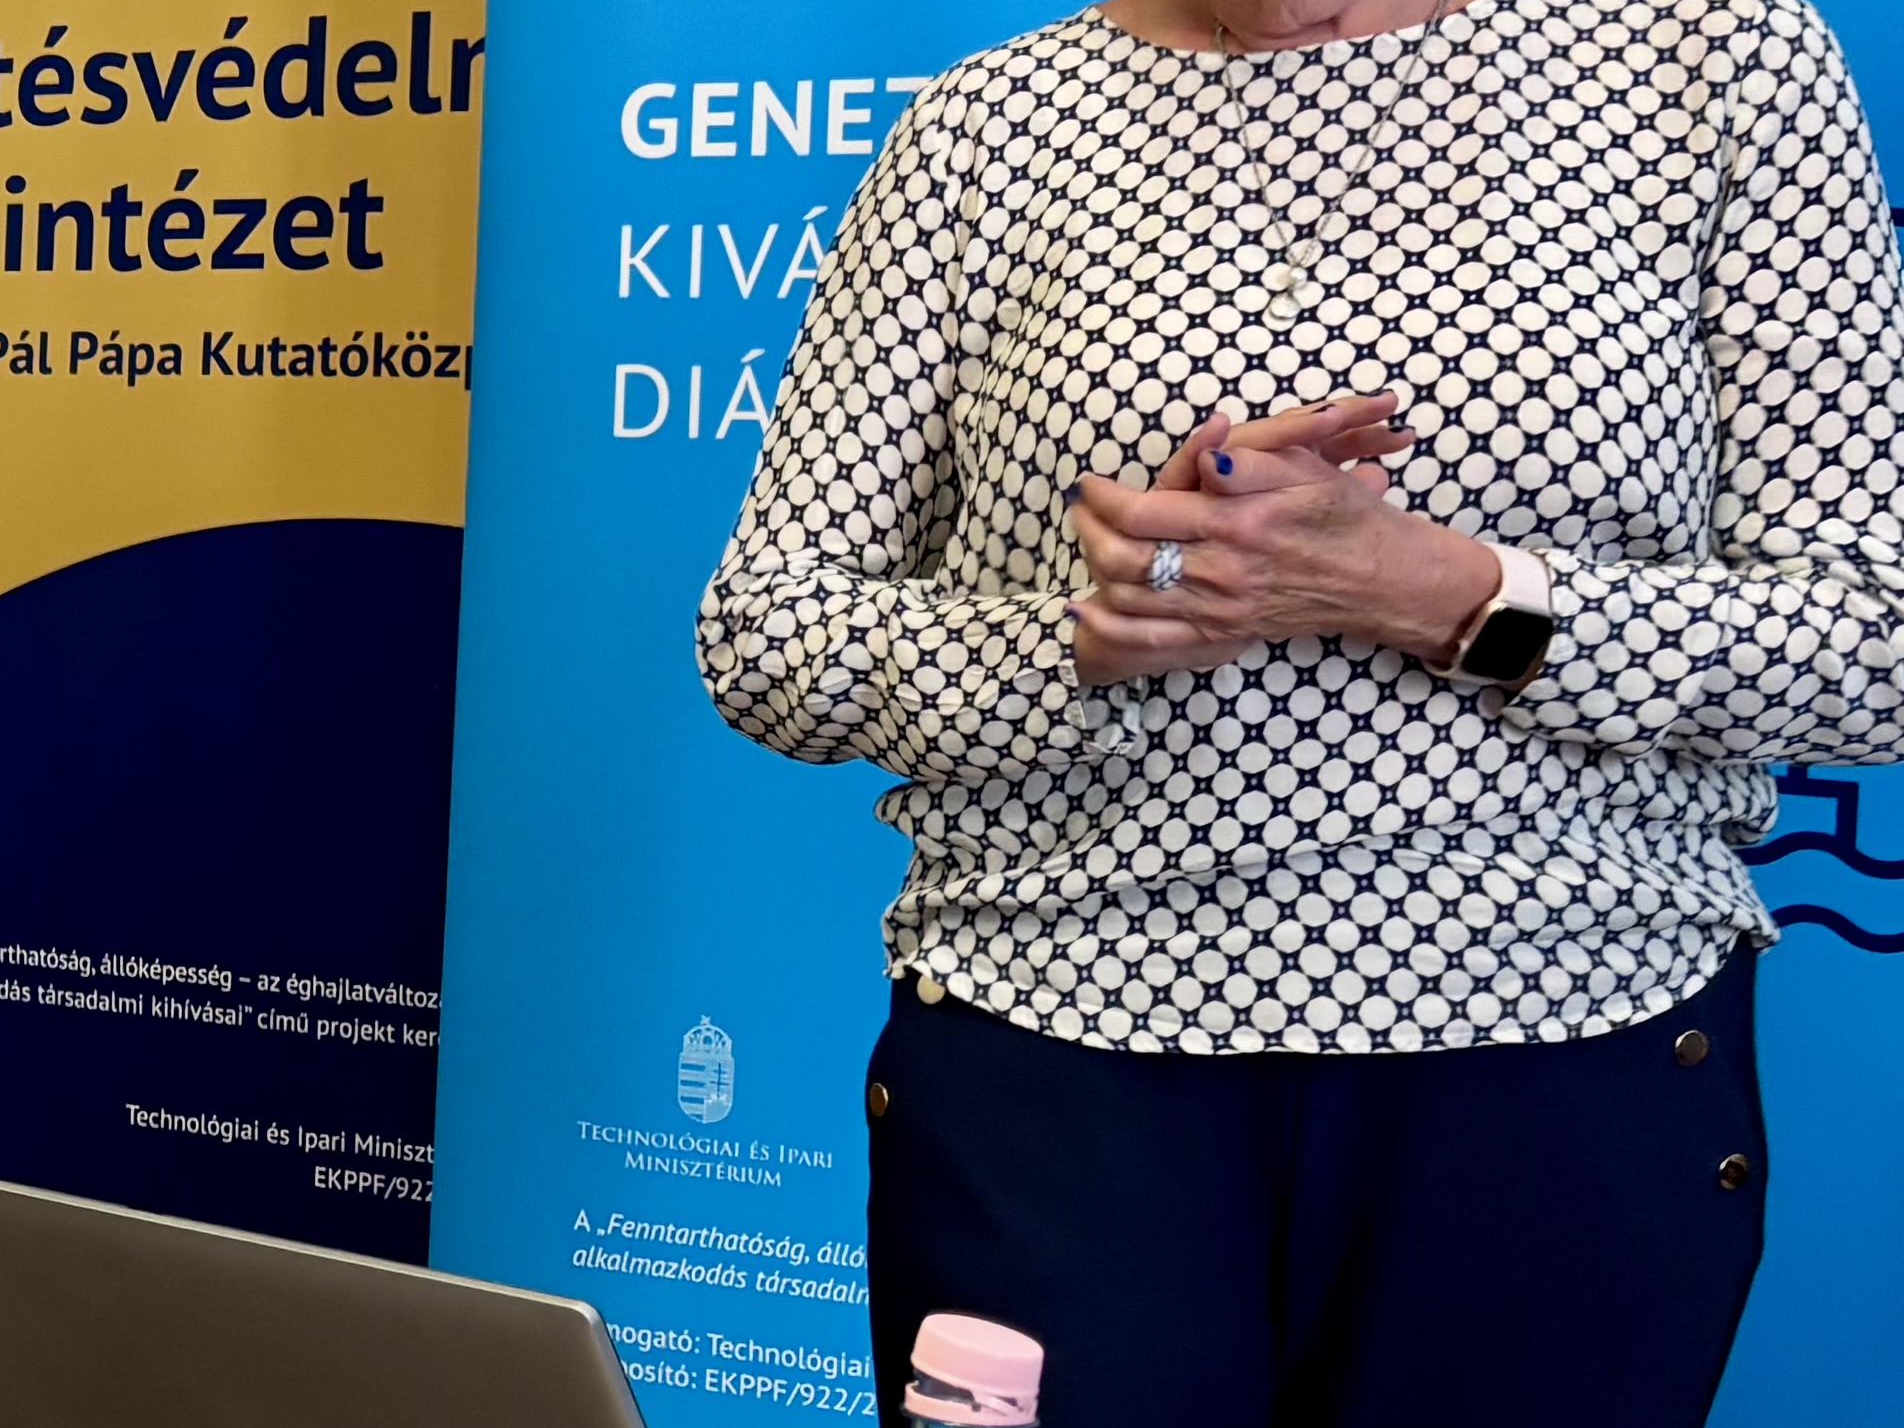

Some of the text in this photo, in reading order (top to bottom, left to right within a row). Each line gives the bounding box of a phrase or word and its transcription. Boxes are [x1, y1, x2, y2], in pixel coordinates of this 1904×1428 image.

[618, 206, 828, 300] KIVÁ
[69, 328, 184, 387] Pápa
[613, 349, 773, 440] DIÁ
[100, 953, 232, 992] állóképesség
[257, 974, 280, 992] az
[286, 973, 442, 1009] éghajlatváltoz
[38, 983, 143, 1015] társadalmi
[257, 1008, 309, 1033] című
[317, 1018, 395, 1045] projekt
[402, 1023, 441, 1047] ker
[126, 1103, 435, 1164] Technológiai és Ipari Miniszt
[624, 1151, 782, 1187] MINISZTÉRIUM
[573, 1209, 591, 1233] A
[817, 1241, 868, 1268] álló
[573, 1246, 747, 1289] alkalmazkodás
[707, 1333, 871, 1379] Technológiai
